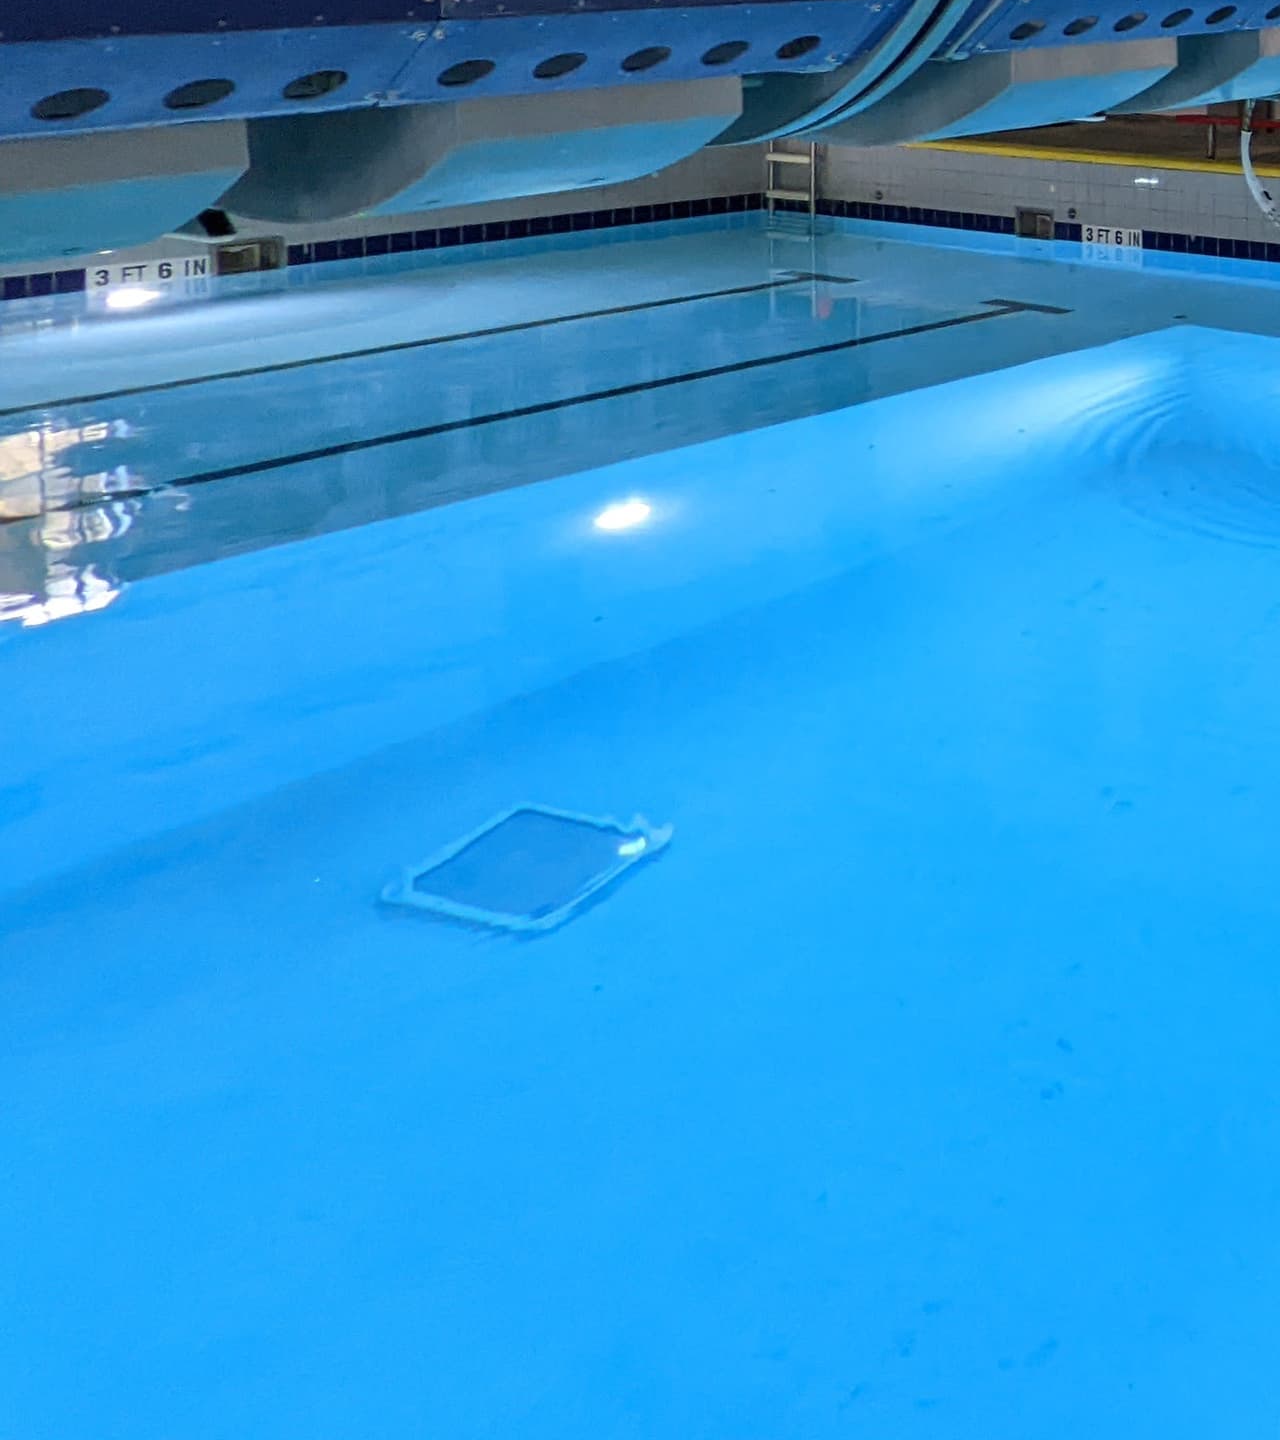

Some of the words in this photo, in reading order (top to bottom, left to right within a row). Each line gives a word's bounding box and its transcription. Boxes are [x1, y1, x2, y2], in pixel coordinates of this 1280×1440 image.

[1086, 227, 1093, 242] 3
[1097, 228, 1110, 244] FT
[1115, 230, 1123, 245] 6
[1128, 231, 1140, 247] IN
[95, 269, 109, 286] 3
[121, 265, 147, 282] FT
[158, 262, 173, 279] 6
[184, 258, 207, 277] IN
